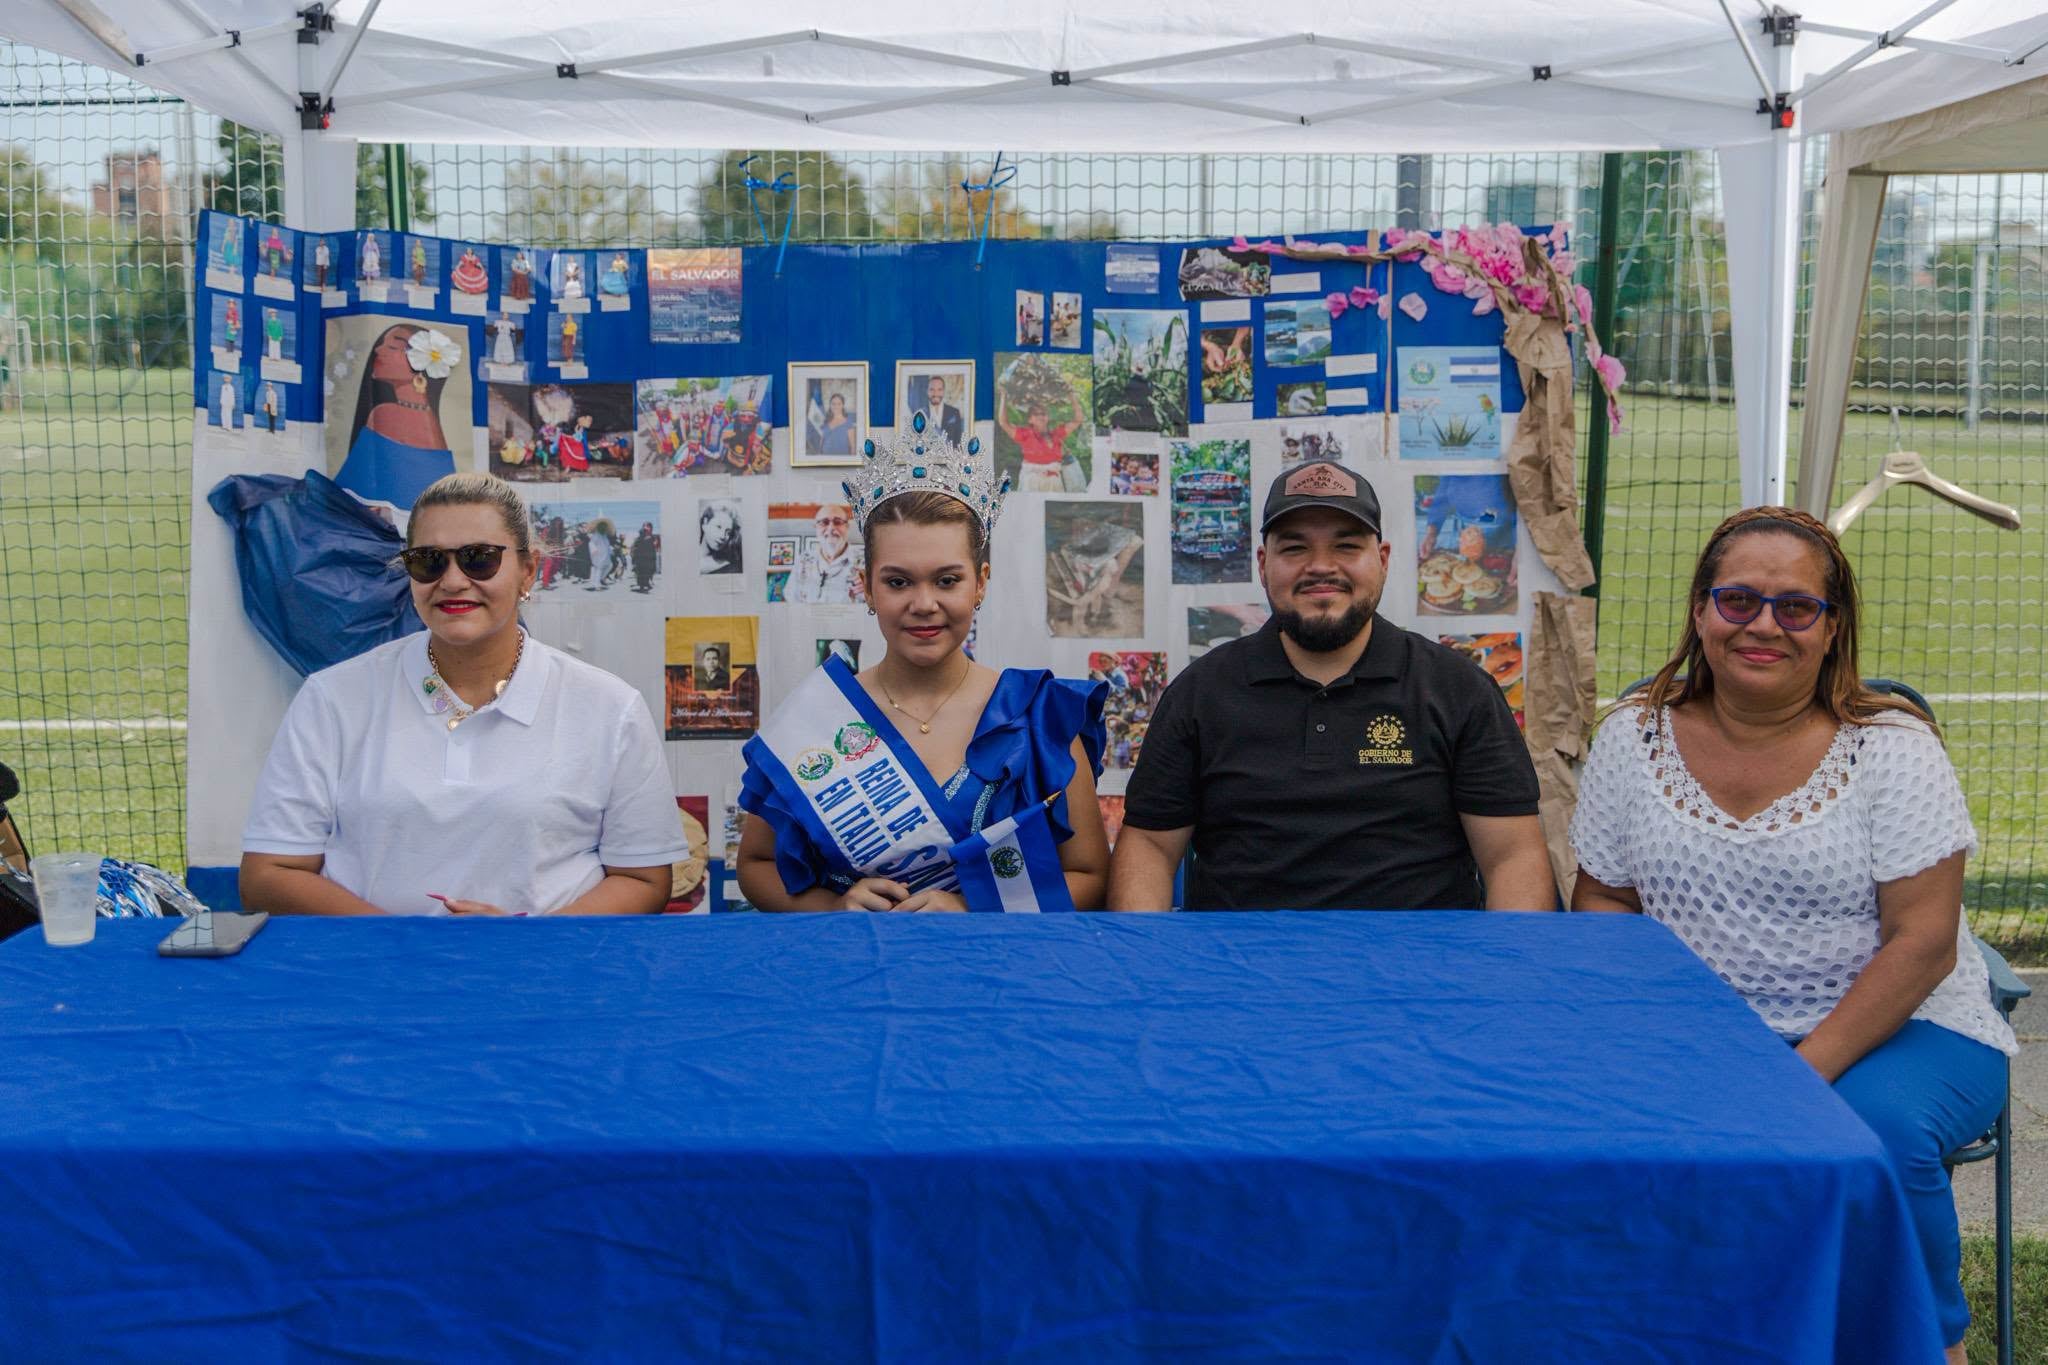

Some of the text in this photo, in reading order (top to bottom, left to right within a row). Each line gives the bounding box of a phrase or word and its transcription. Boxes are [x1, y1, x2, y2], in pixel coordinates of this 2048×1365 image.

[652, 269, 739, 281] EL SALVADOR
[1317, 475, 1332, 483] ANA
[1359, 749, 1413, 758] GOBIERNO DE
[1372, 757, 1414, 765] SALVADOR
[855, 758, 928, 840] REINA DE
[814, 776, 892, 867] EN ITALIA
